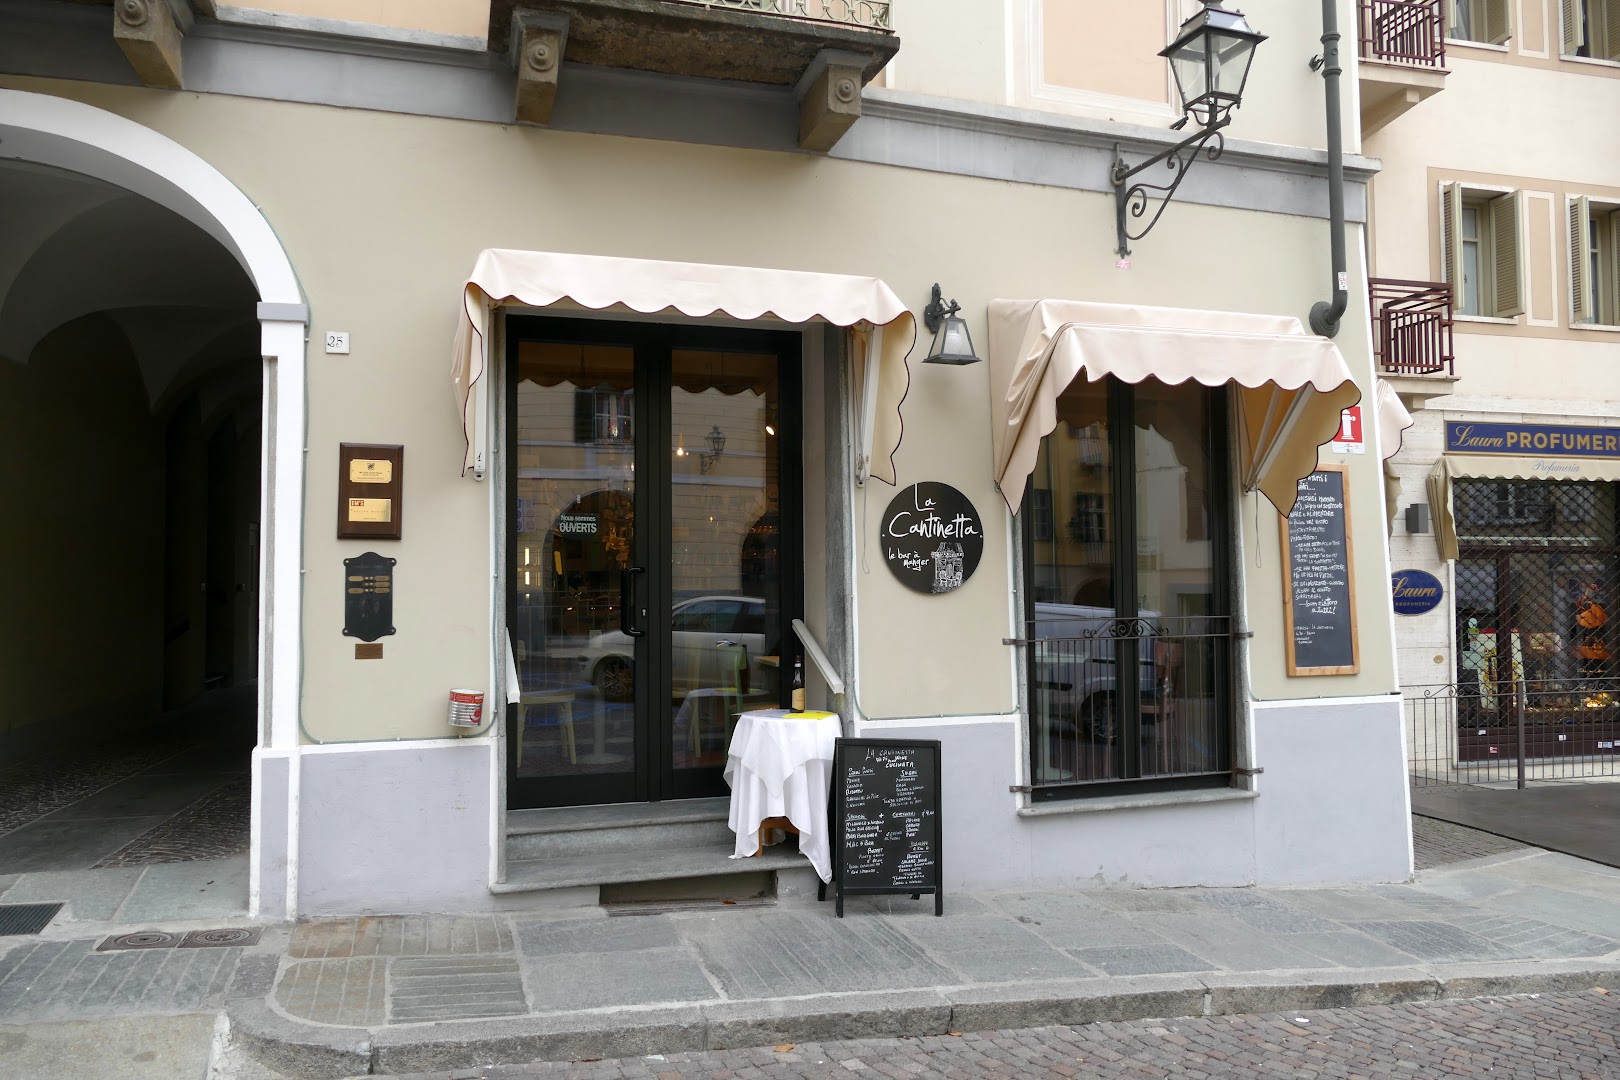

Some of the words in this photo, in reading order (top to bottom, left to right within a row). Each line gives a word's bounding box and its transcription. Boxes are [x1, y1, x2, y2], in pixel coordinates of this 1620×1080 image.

[327, 335, 343, 348] 25
[1451, 426, 1504, 447] Laura
[1506, 431, 1620, 450] PROFUMER
[1532, 460, 1580, 475] Profumeria
[914, 483, 937, 511] La
[559, 522, 597, 533] OUVERTS
[889, 511, 979, 538] Cantinetta
[888, 547, 896, 560] le
[897, 548, 912, 559] bar
[913, 550, 920, 559] à
[903, 558, 930, 571] manger
[1392, 577, 1437, 597] Laura
